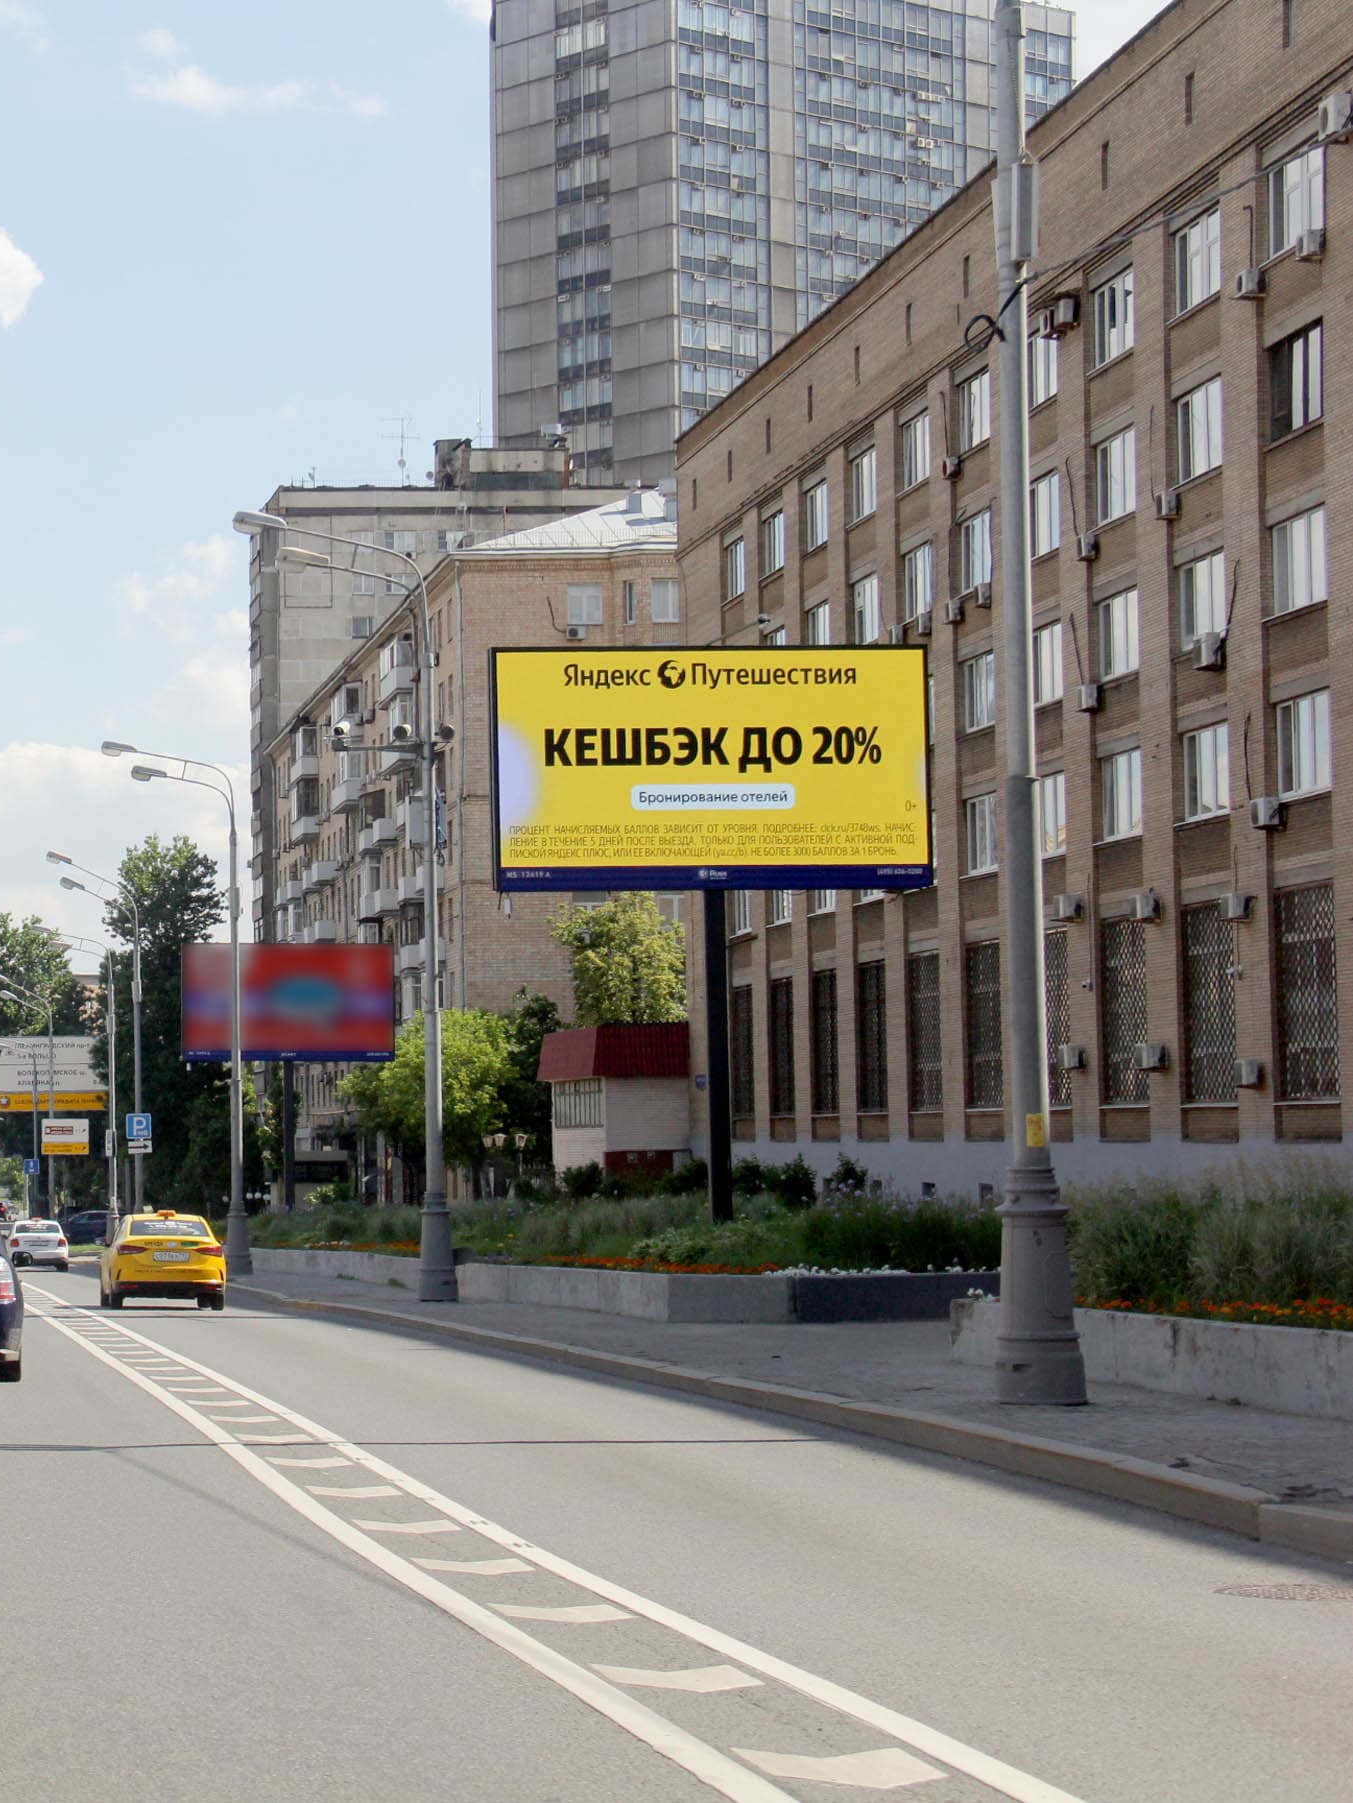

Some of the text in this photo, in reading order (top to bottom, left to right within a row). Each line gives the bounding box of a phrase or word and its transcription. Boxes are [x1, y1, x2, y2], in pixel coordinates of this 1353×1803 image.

[563, 663, 857, 690] Яндекс Путешествия
[544, 725, 882, 773] КЕШБЭК ДО 20%
[638, 788, 788, 806] Бронирование отелей
[904, 799, 917, 812] 0+
[509, 825, 551, 836] ПРОЦЕНТ
[554, 824, 621, 835] НАЧИСЛЯЕМЫХ
[624, 824, 660, 834] БАЛЛОВ
[663, 823, 704, 834] ЗАВИСИТ
[707, 823, 719, 833] ОТ
[510, 836, 539, 847] ЛЕНИЕ
[549, 836, 589, 847] ТЕЧЕНИЕ
[590, 836, 597, 846] 5
[598, 834, 624, 847] ДНЕЙ
[626, 835, 656, 846] ПОСЛЕ
[699, 835, 735, 845] ТОЛЬКО
[737, 835, 756, 846] ДЛЯ
[758, 833, 833, 845] ПОЛЬЗОВАТЕЛЕЙ
[835, 834, 842, 845] С
[844, 832, 893, 845] АКТИВНОЙ
[510, 847, 547, 858] ПИСКОЙ
[547, 848, 581, 859] ЯНДЕКС
[613, 848, 632, 858] ИЛИ
[633, 848, 645, 858] ЕЕ
[645, 846, 711, 858] ВКЛЮЧАЮЩЕЙ
[750, 847, 763, 857] НЕ
[763, 847, 792, 857] БОЛЕЕ
[793, 846, 811, 857] 3000
[812, 846, 848, 857] БАЛЛОВ
[849, 846, 861, 856] ЗА
